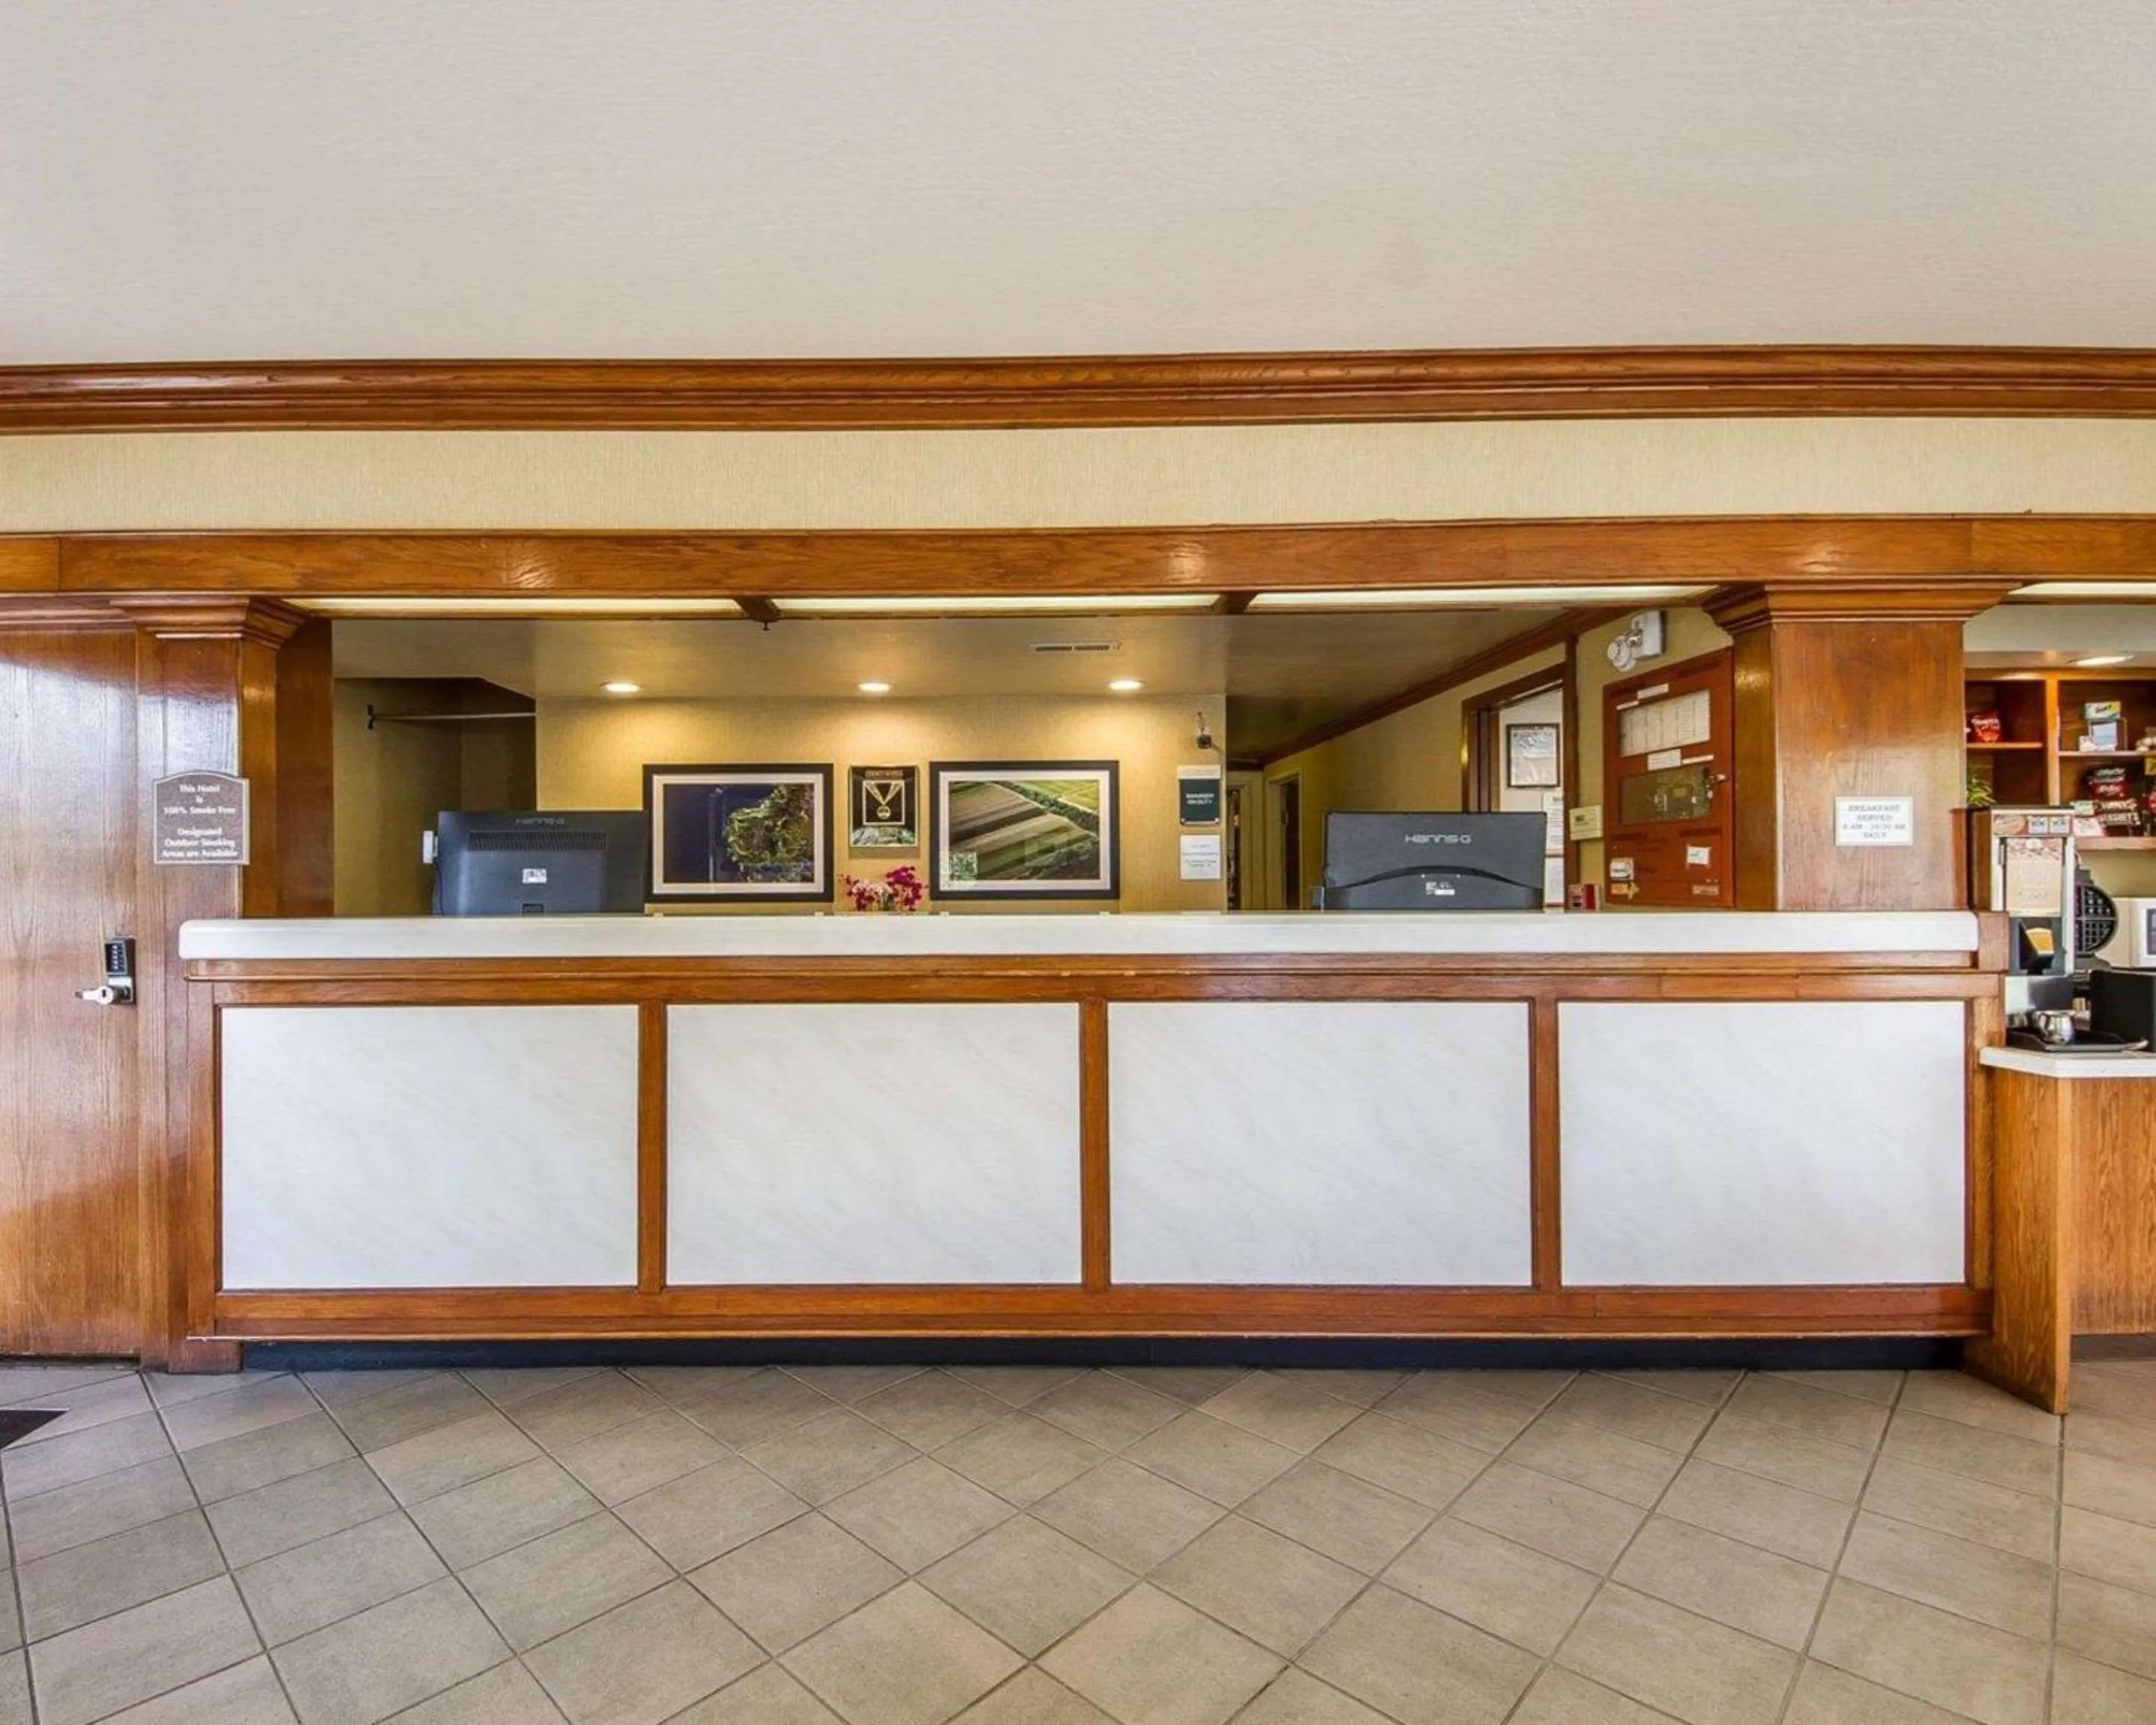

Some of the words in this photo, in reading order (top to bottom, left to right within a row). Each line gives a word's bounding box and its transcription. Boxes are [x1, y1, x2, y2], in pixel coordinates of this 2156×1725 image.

[179, 784, 195, 793] This
[197, 784, 220, 793] Hotel
[189, 806, 216, 815] Smoke
[218, 806, 237, 815] Free
[177, 827, 222, 837] Designated
[165, 838, 198, 847] Outdoor
[200, 838, 236, 848] Smoking
